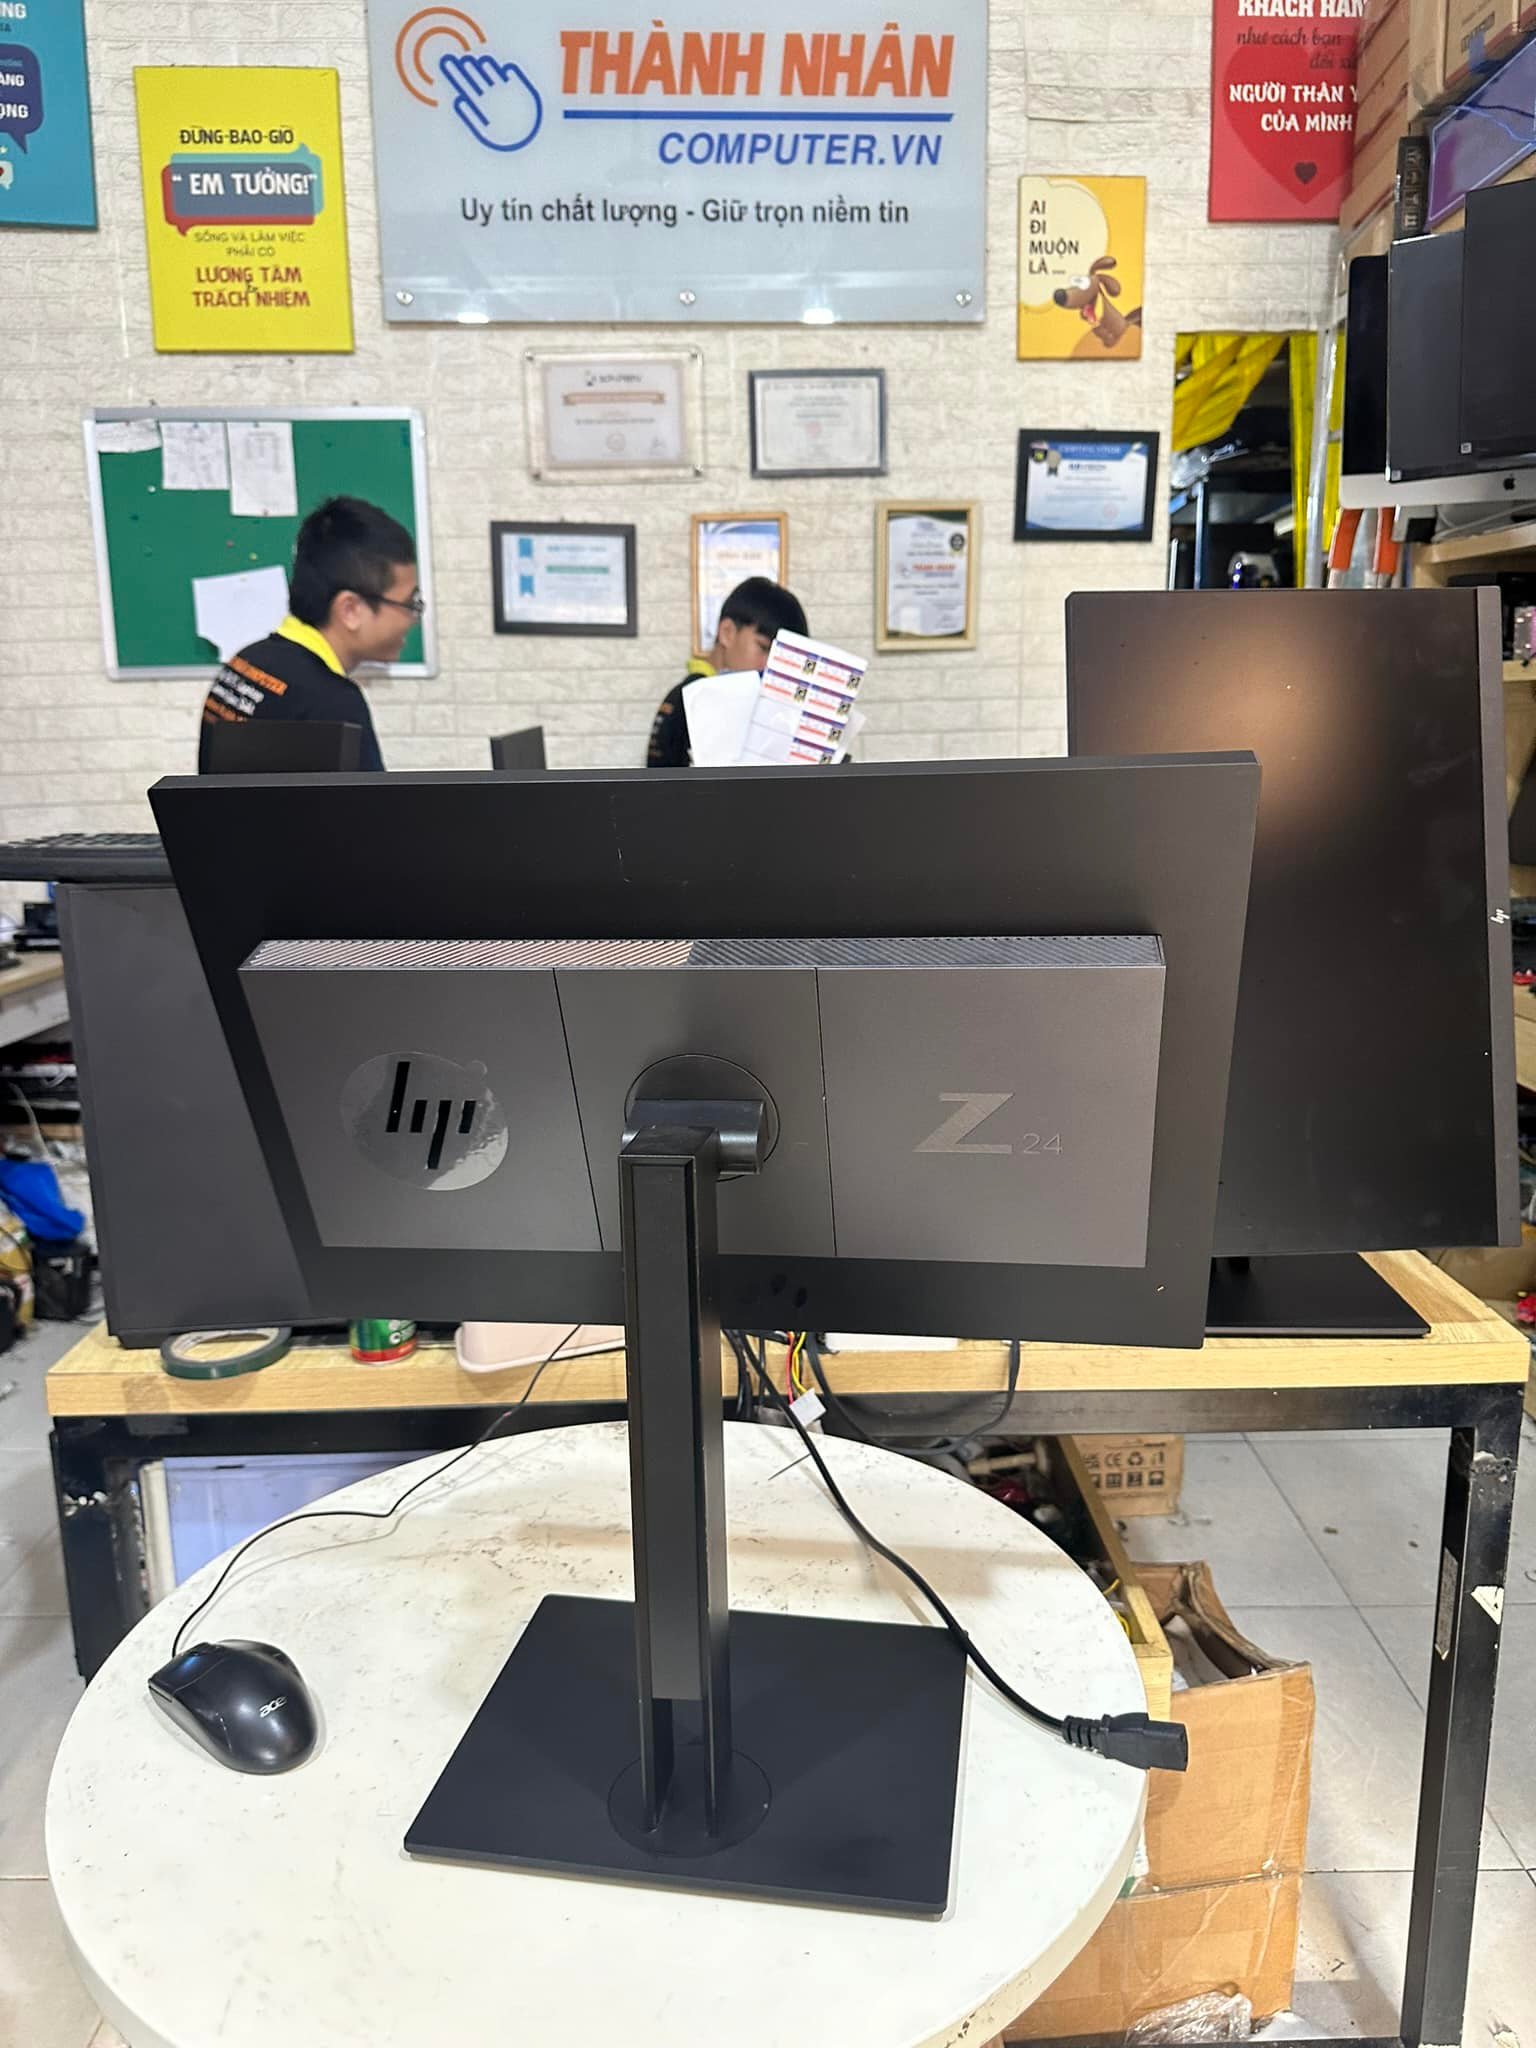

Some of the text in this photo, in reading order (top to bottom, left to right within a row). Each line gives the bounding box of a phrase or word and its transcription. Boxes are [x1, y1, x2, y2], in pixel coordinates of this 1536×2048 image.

[561, 19, 954, 97] THÀNH NHÂN
[1229, 82, 1287, 103] NGƯỜI
[1292, 82, 1344, 103] THÂN
[1260, 109, 1353, 132] CỦA MÌNH
[658, 131, 942, 166] COMPUTER.VN
[189, 173, 224, 195] EM
[461, 198, 494, 227] Uy
[502, 198, 533, 221] tín
[542, 193, 595, 221] chất
[603, 198, 677, 228] lượng
[702, 198, 748, 222] Giữ
[755, 201, 804, 228] trọn
[812, 195, 871, 222] niềm
[879, 201, 909, 223] tin
[1029, 199, 1046, 215] AI
[1029, 219, 1046, 234] ĐI
[1029, 237, 1079, 259] MUỘN
[912, 1091, 1063, 1155] Z 24
